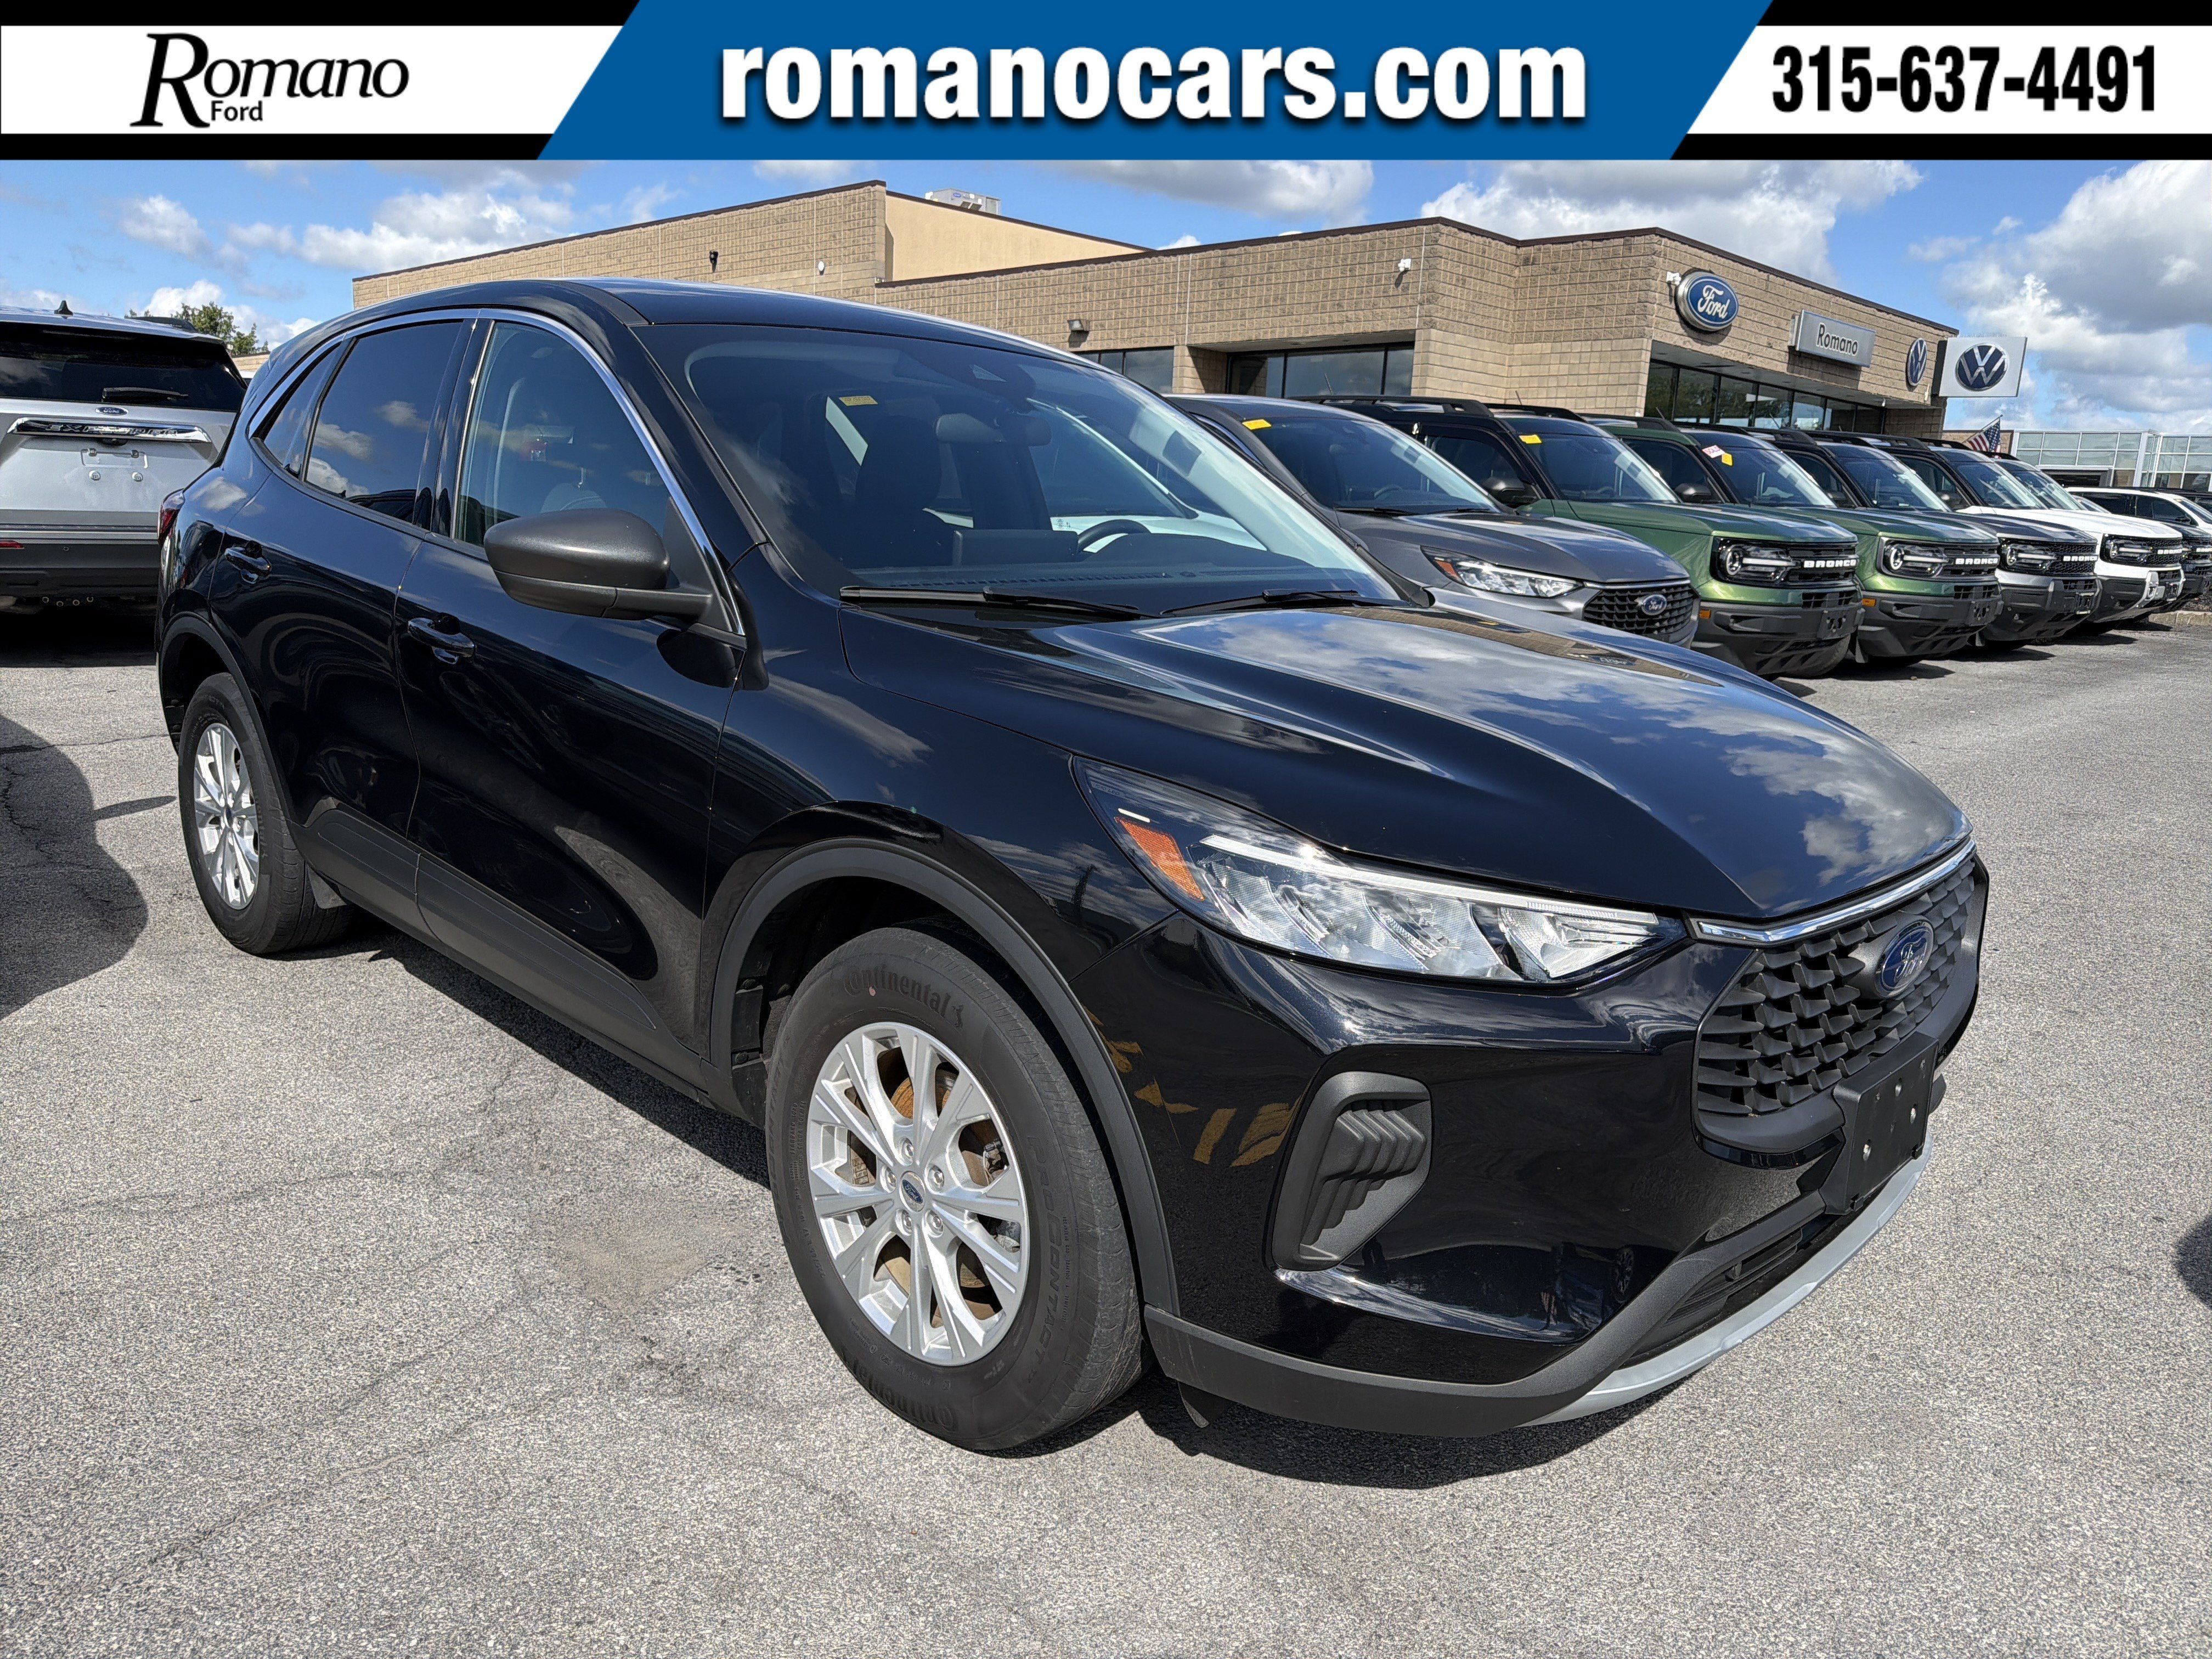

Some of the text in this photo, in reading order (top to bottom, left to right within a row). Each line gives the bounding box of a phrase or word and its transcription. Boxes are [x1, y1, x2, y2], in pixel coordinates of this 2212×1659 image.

[1697, 285, 1730, 319] Ford
[1816, 323, 1859, 356] Romano
[1803, 559, 1857, 568] BRONCO
[1648, 600, 1663, 611] Ford
[1893, 935, 1928, 984] Ford
[843, 963, 952, 1018] Continental
